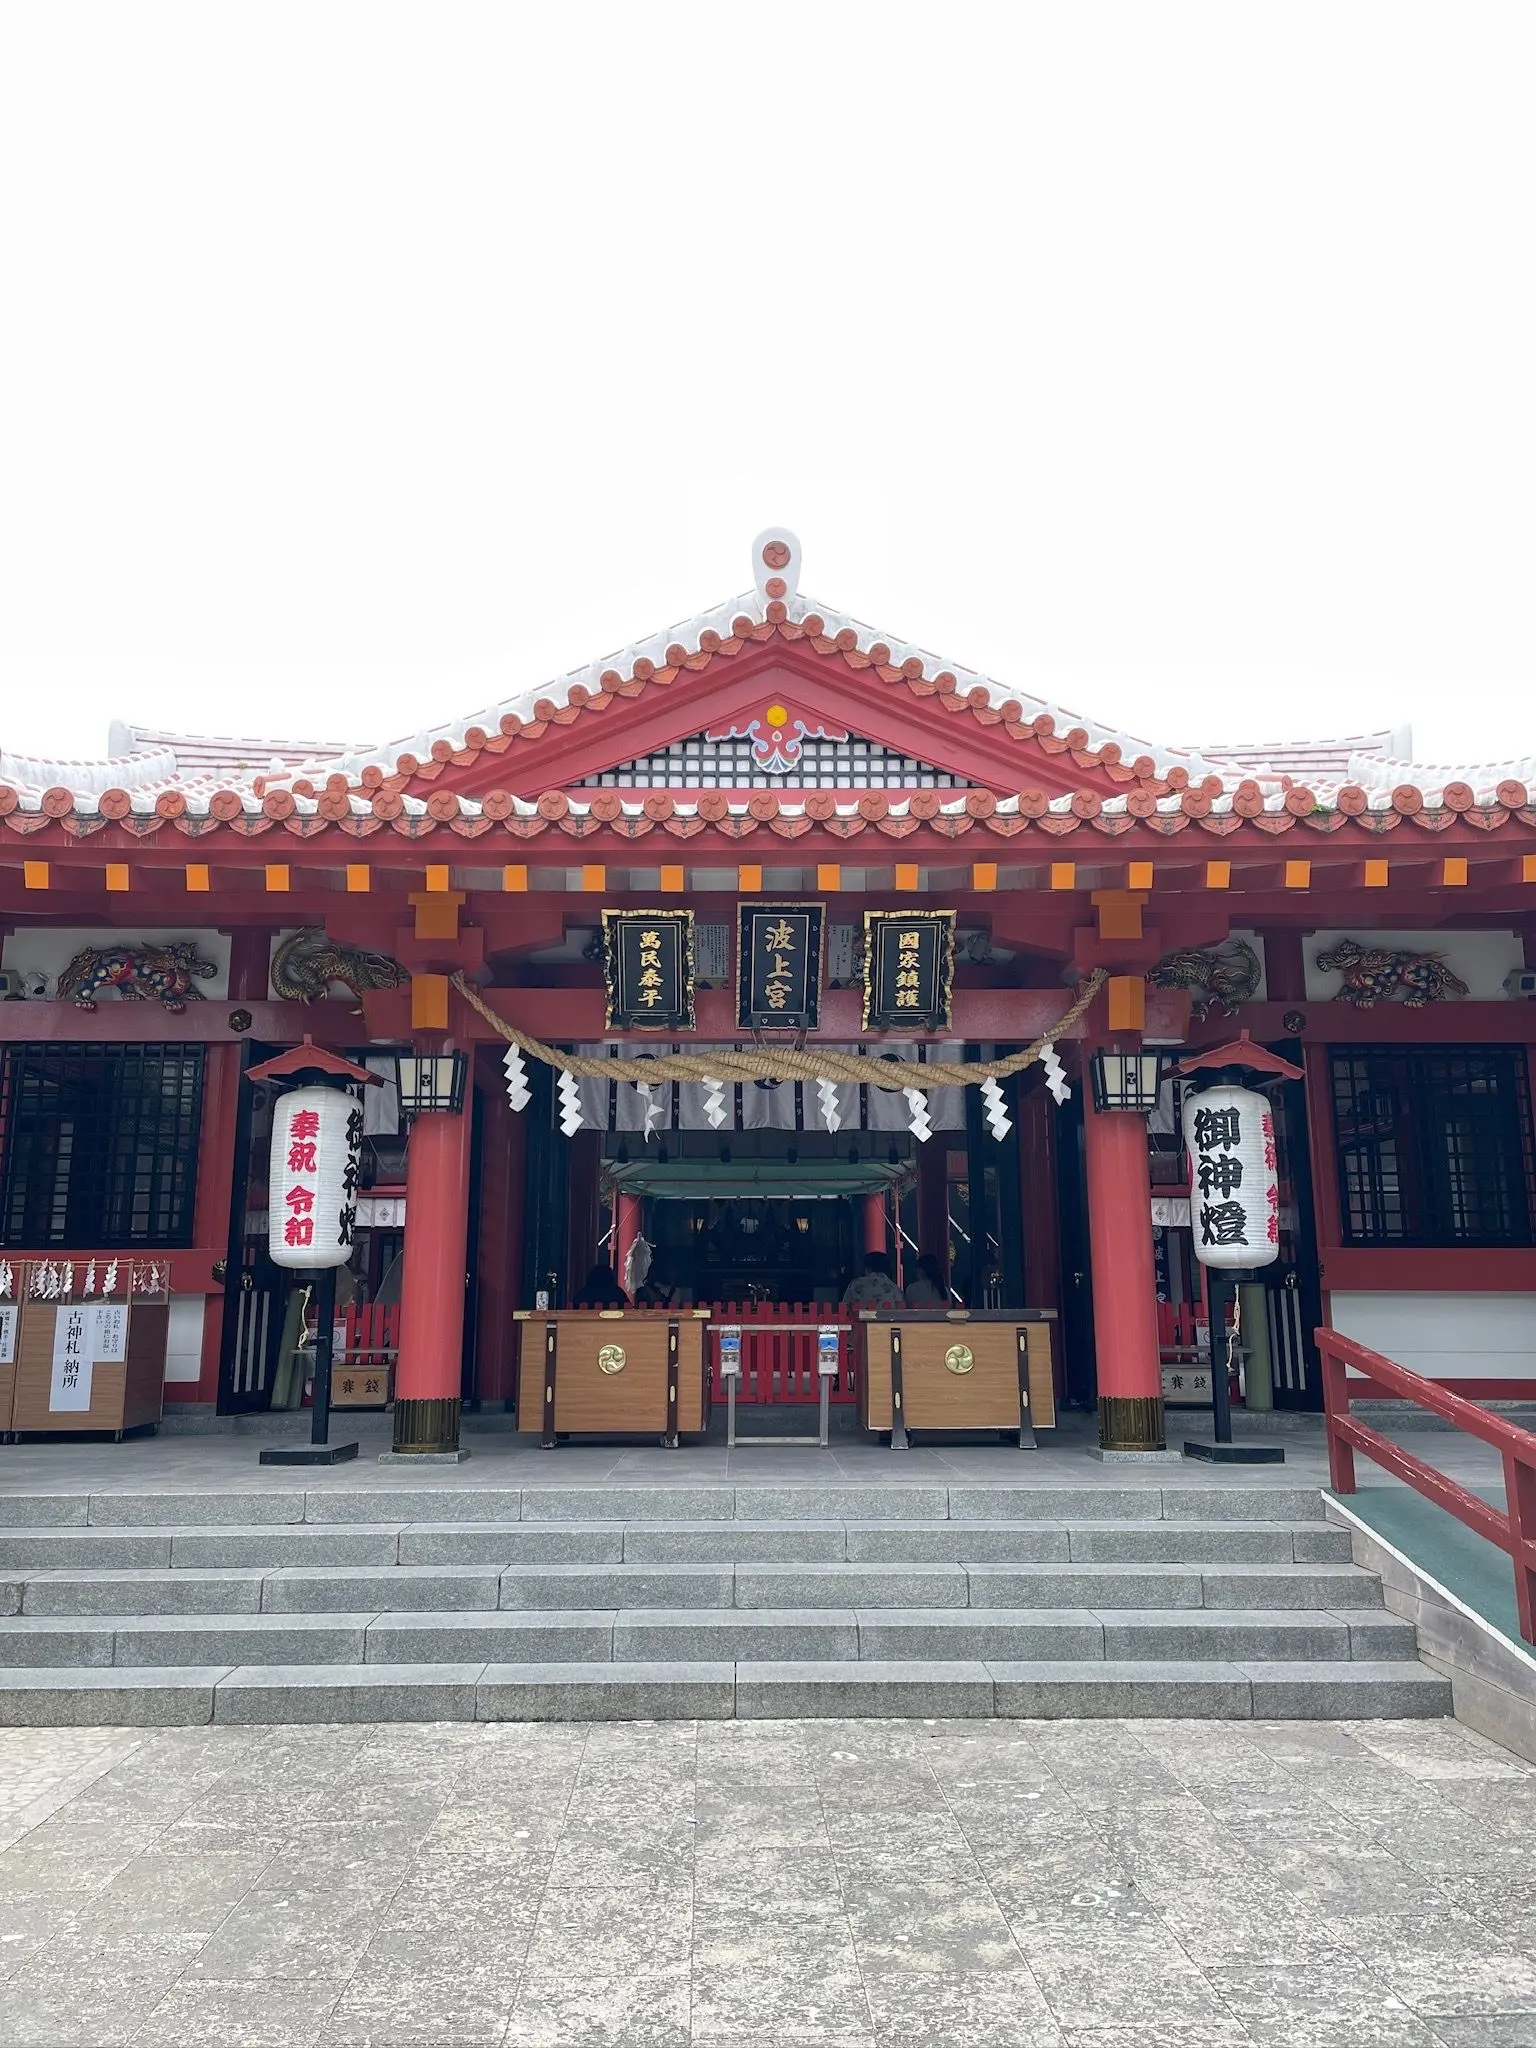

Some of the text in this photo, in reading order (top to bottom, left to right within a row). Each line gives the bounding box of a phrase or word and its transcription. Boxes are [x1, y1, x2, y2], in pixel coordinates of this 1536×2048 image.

[637, 931, 664, 1008] 萬民泰平
[764, 919, 796, 1009] 波上宮
[894, 931, 921, 1008] 國家鎮護
[284, 1110, 319, 1247] 奉祝 令和
[1194, 1106, 1248, 1246] 御神燈
